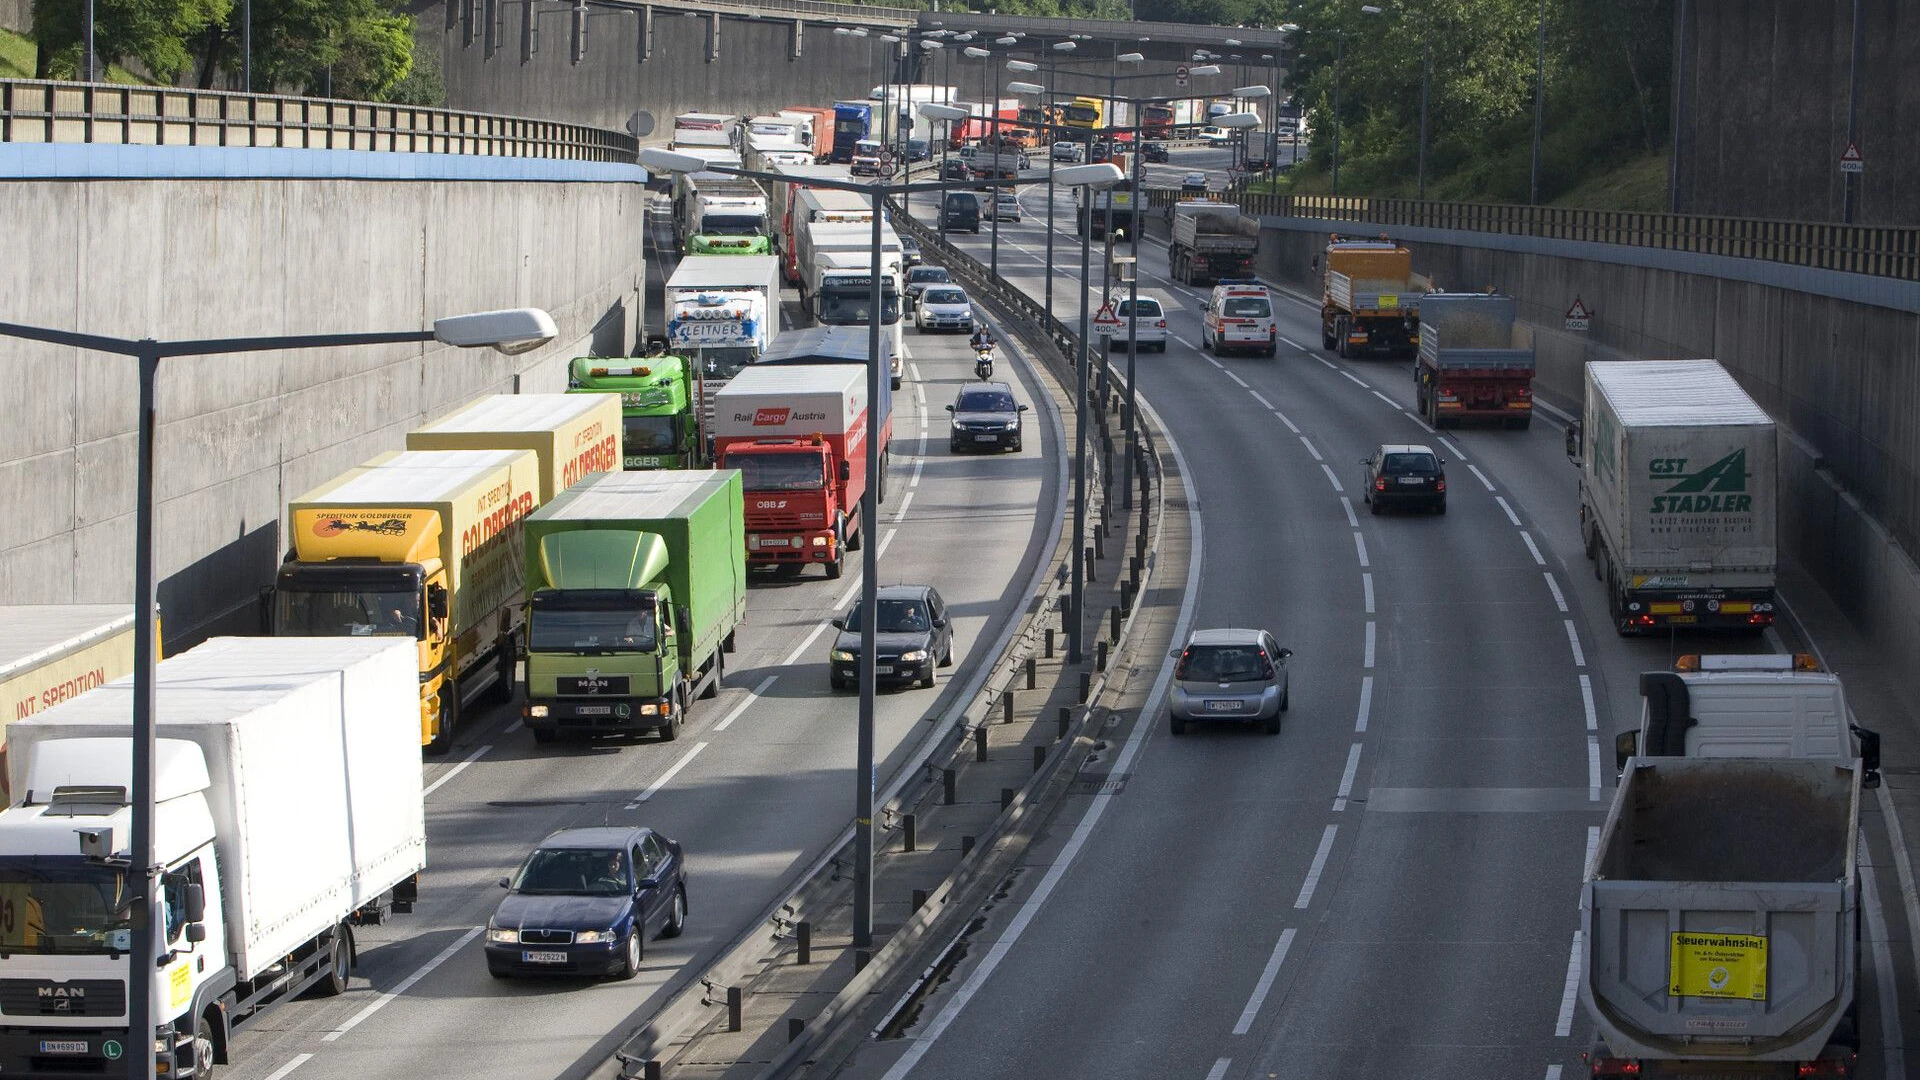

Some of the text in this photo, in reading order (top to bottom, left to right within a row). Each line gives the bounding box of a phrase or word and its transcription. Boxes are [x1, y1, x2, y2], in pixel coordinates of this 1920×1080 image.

[825, 277, 893, 285] GLOBETROER
[686, 322, 738, 336] LEITNER
[734, 412, 826, 424] Rail Cargo Austria
[1649, 459, 1688, 473] GST
[1649, 494, 1752, 513] STADLER
[37, 987, 85, 997] MAN
